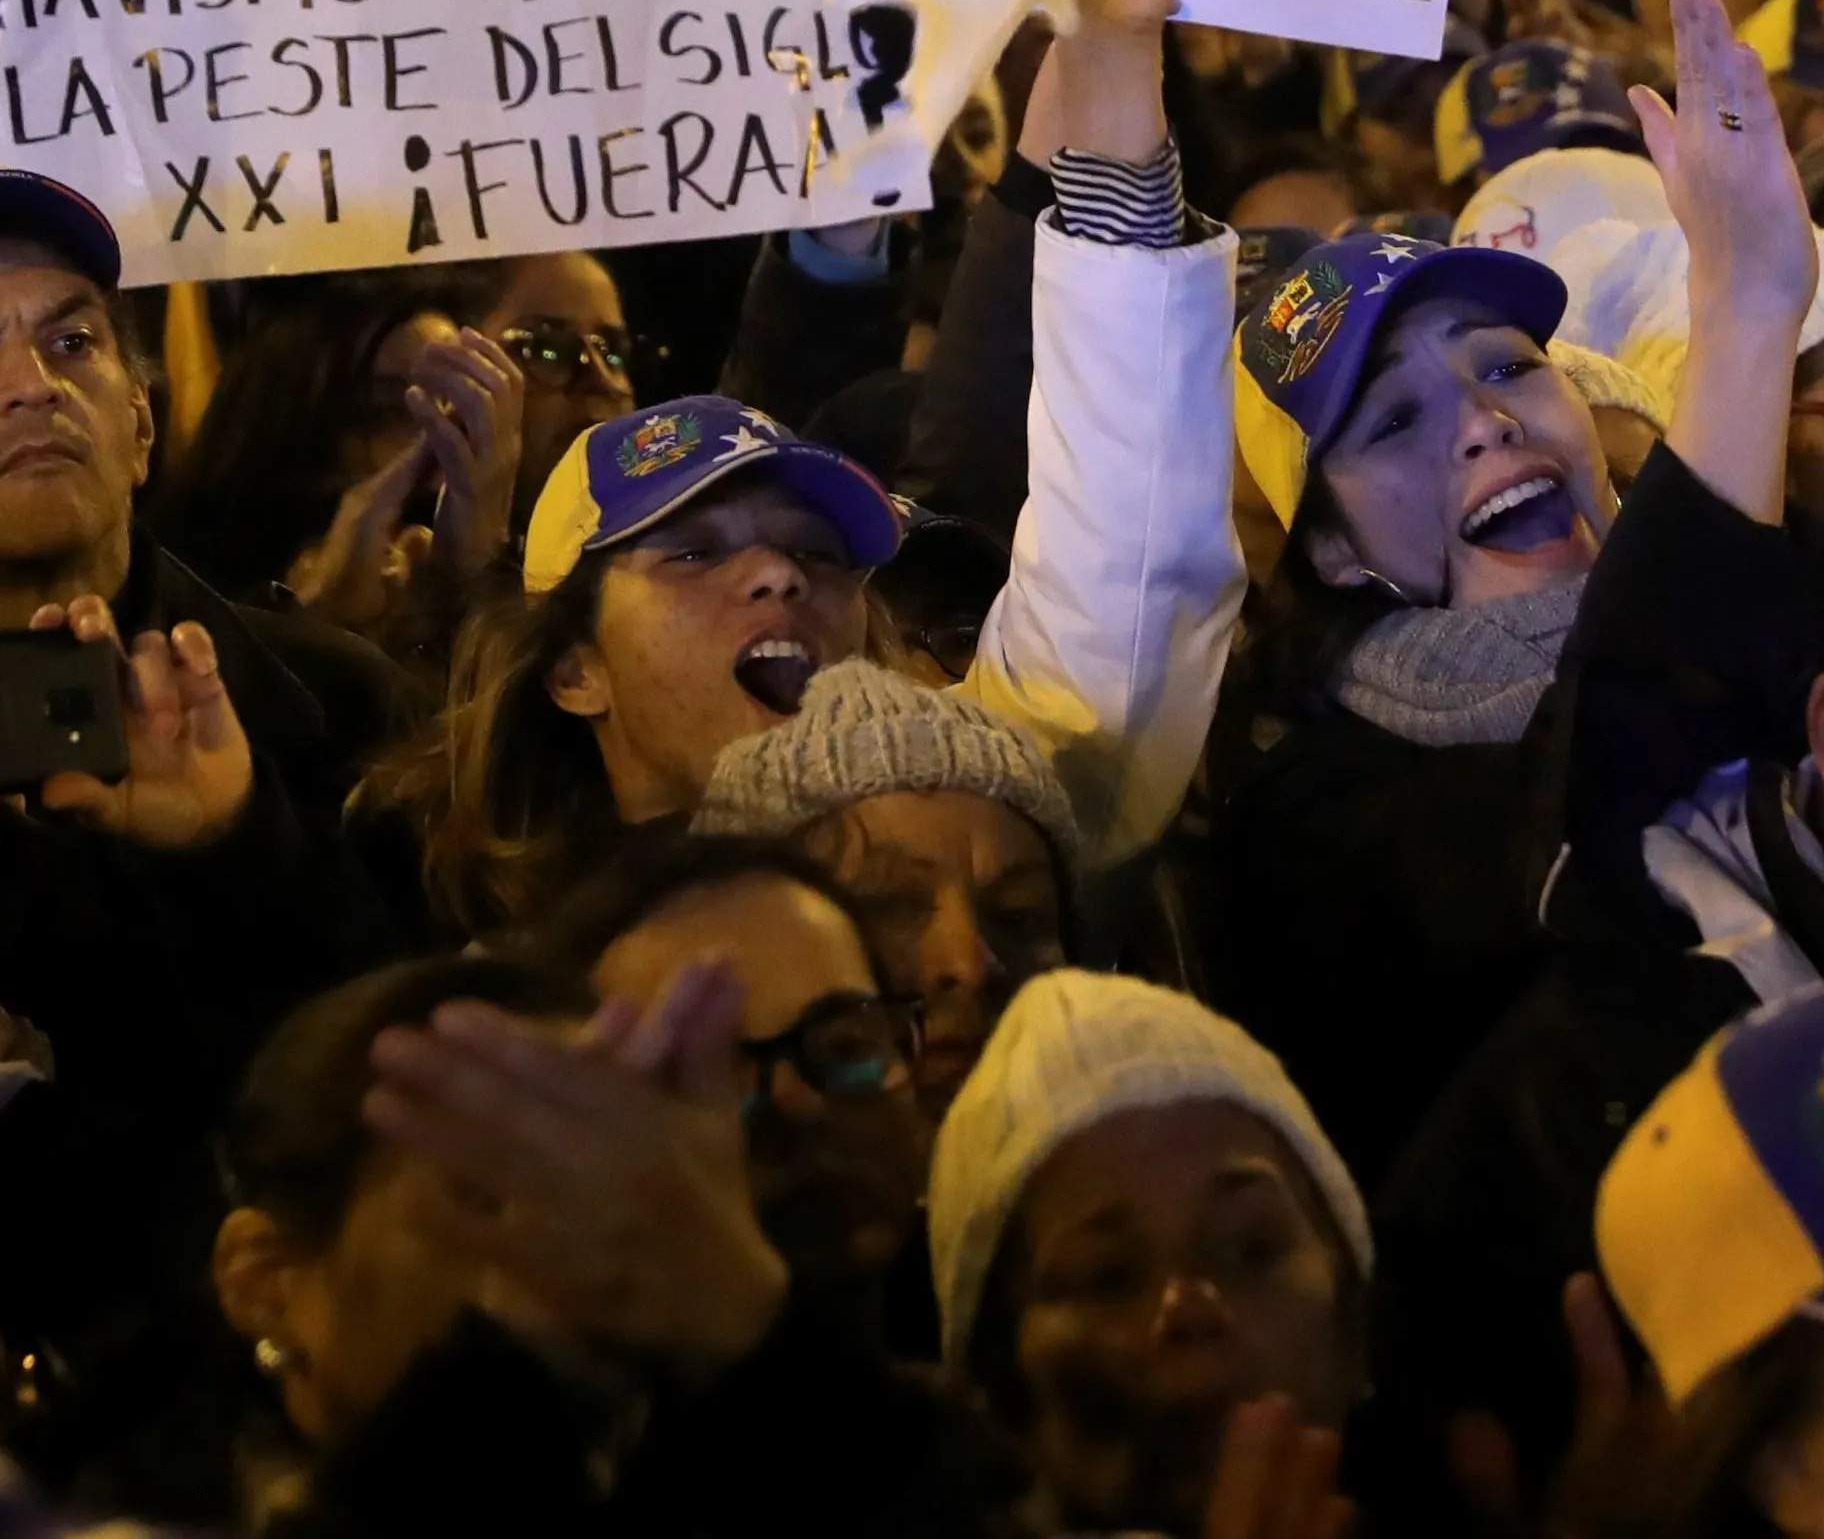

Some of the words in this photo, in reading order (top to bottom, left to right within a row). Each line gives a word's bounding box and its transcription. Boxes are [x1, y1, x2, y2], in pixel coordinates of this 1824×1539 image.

[4, 57, 116, 144] LA
[132, 25, 448, 124] PESTE
[485, 15, 644, 109] DEL
[165, 147, 341, 243] XXI
